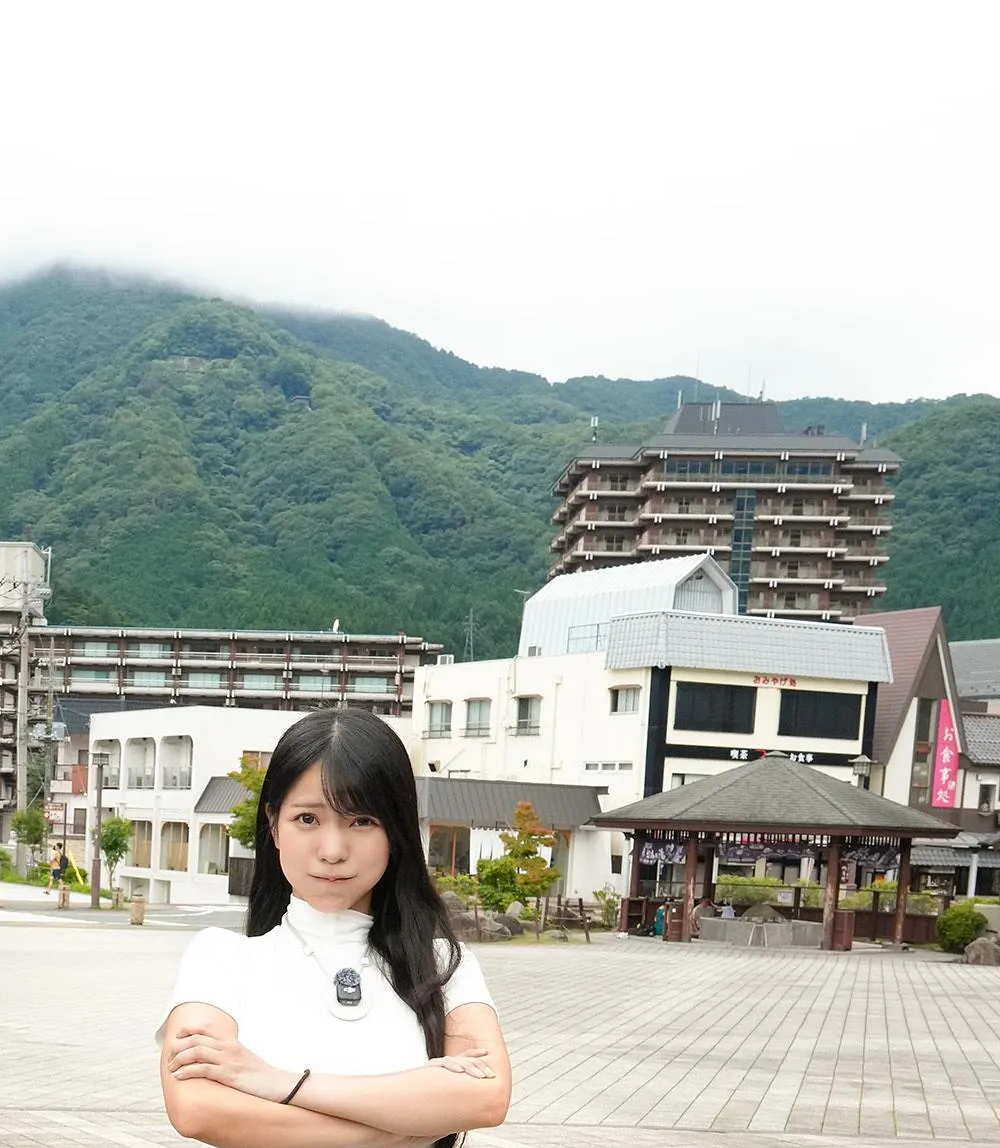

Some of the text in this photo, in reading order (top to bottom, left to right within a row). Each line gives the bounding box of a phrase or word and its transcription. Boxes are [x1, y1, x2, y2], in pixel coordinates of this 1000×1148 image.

[753, 675, 797, 687] おみやげ処
[730, 749, 749, 760] 喫茶
[789, 752, 814, 764] お食事
[936, 727, 957, 804] お食事処
